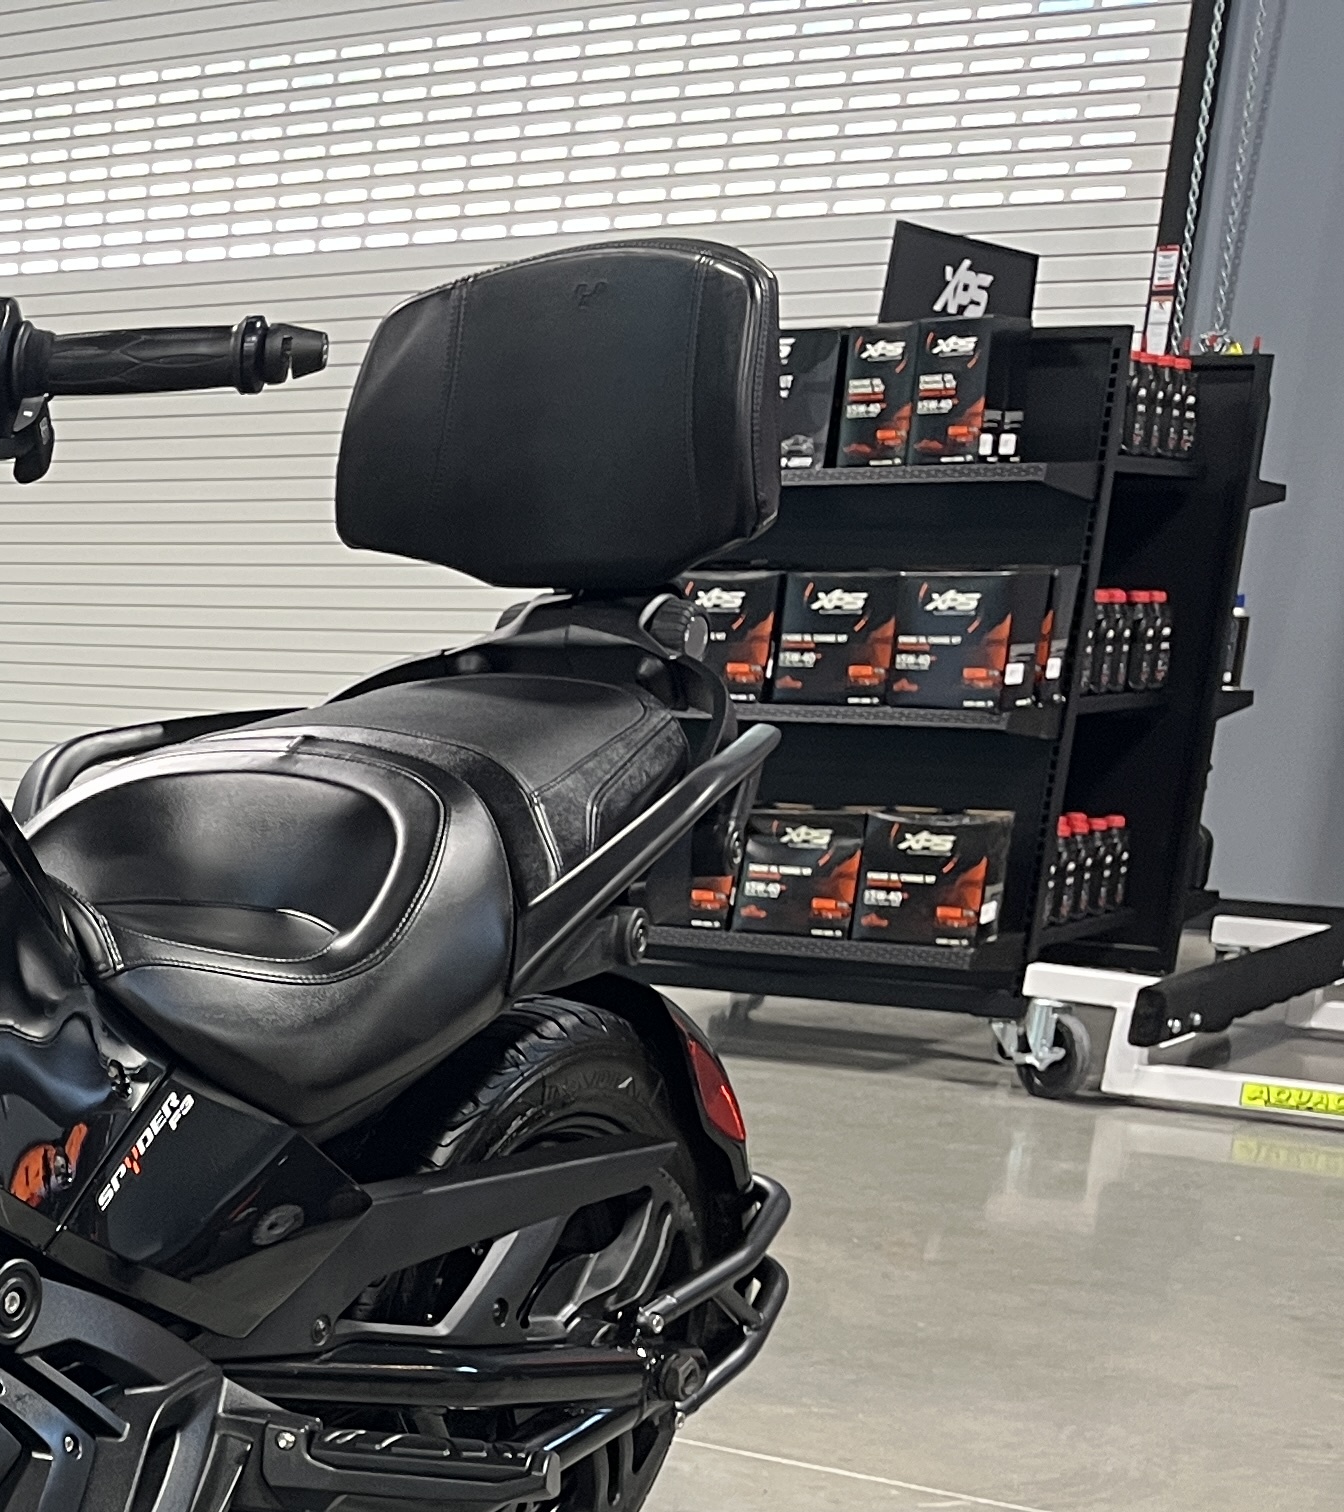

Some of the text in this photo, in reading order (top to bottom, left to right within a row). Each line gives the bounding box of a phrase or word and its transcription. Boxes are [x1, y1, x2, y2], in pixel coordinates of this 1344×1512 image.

[932, 258, 994, 318] XPS
[860, 339, 907, 359] XPS
[931, 334, 979, 354] XPS
[694, 586, 747, 609] XPS
[810, 588, 869, 611] XPS
[923, 588, 983, 612] XPS
[779, 824, 834, 845] XPS
[897, 830, 957, 851] XPS
[168, 1094, 195, 1131] F3
[96, 1091, 180, 1212] SPYDER
